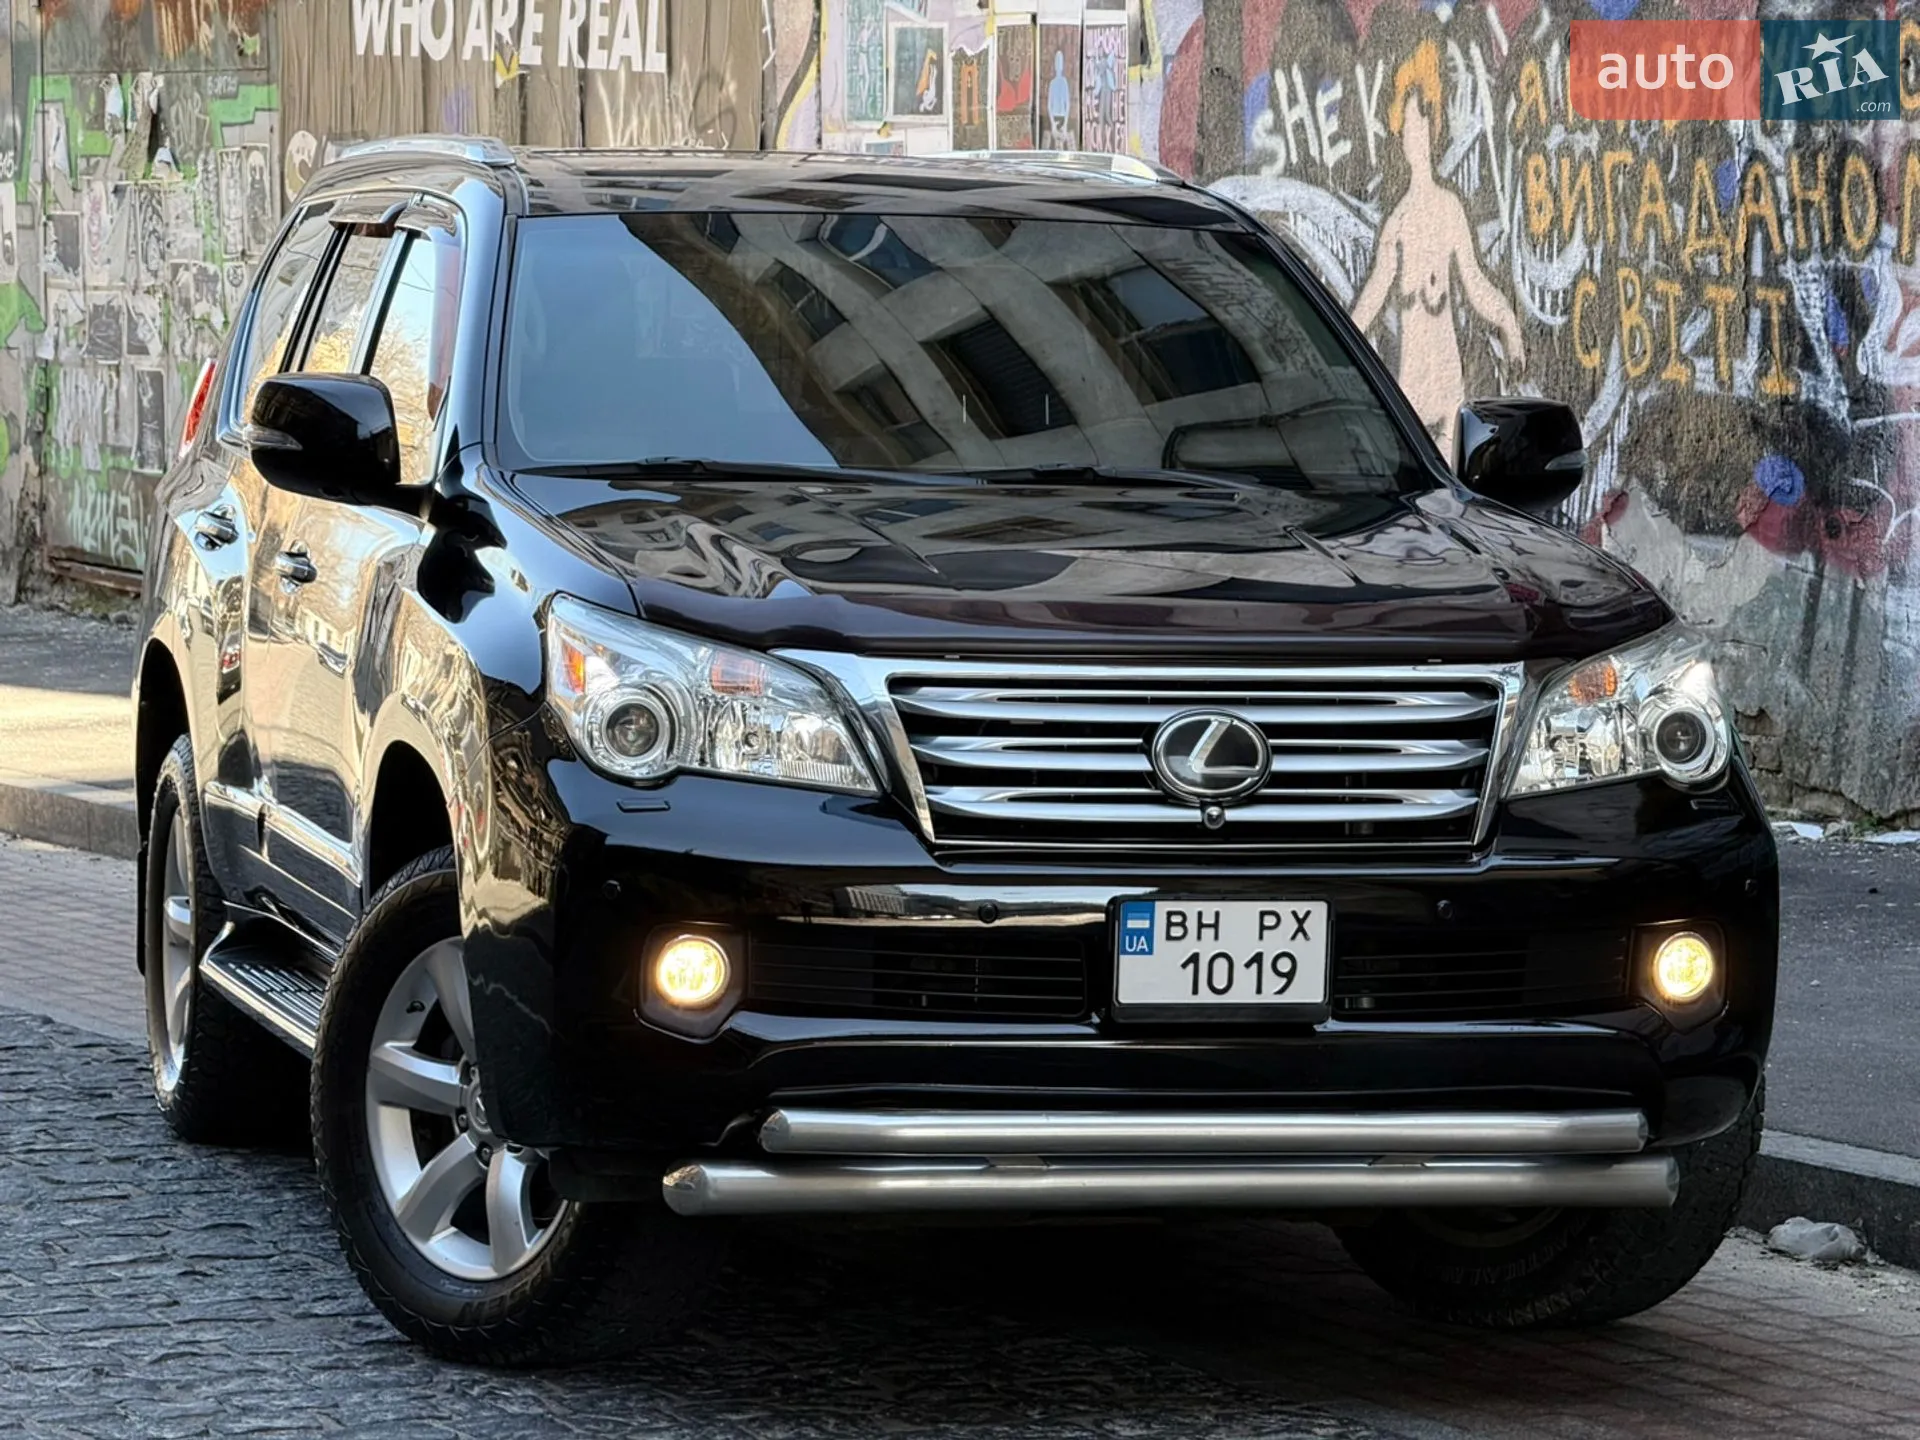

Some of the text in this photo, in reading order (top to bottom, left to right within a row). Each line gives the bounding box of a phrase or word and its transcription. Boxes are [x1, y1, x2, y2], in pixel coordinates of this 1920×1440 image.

[352, 0, 667, 73] WHO ARE REAL
[1125, 935, 1149, 952] UA
[1165, 909, 1312, 941] BH PX
[1181, 951, 1298, 995] 1019
